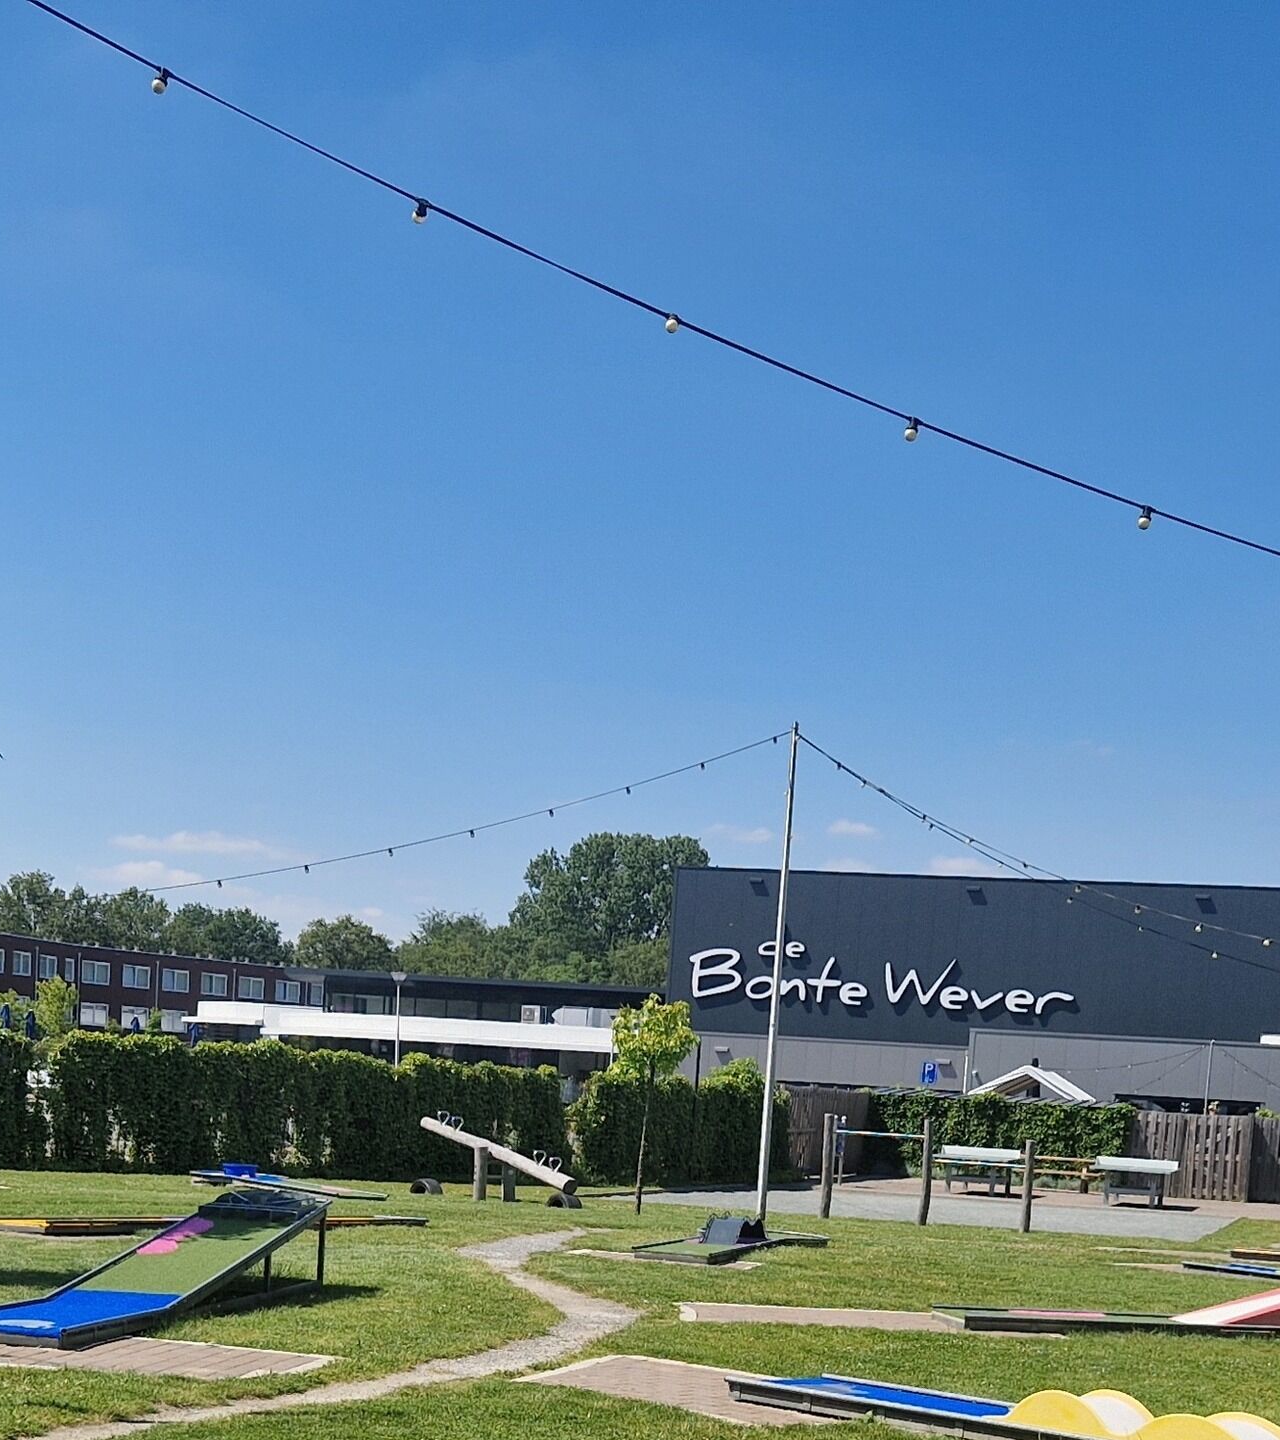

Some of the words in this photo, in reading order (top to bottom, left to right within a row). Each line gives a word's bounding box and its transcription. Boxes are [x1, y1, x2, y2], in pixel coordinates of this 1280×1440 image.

[688, 947, 868, 1006] Bonte
[885, 958, 1075, 1015] Wever
[925, 1063, 934, 1075] P
